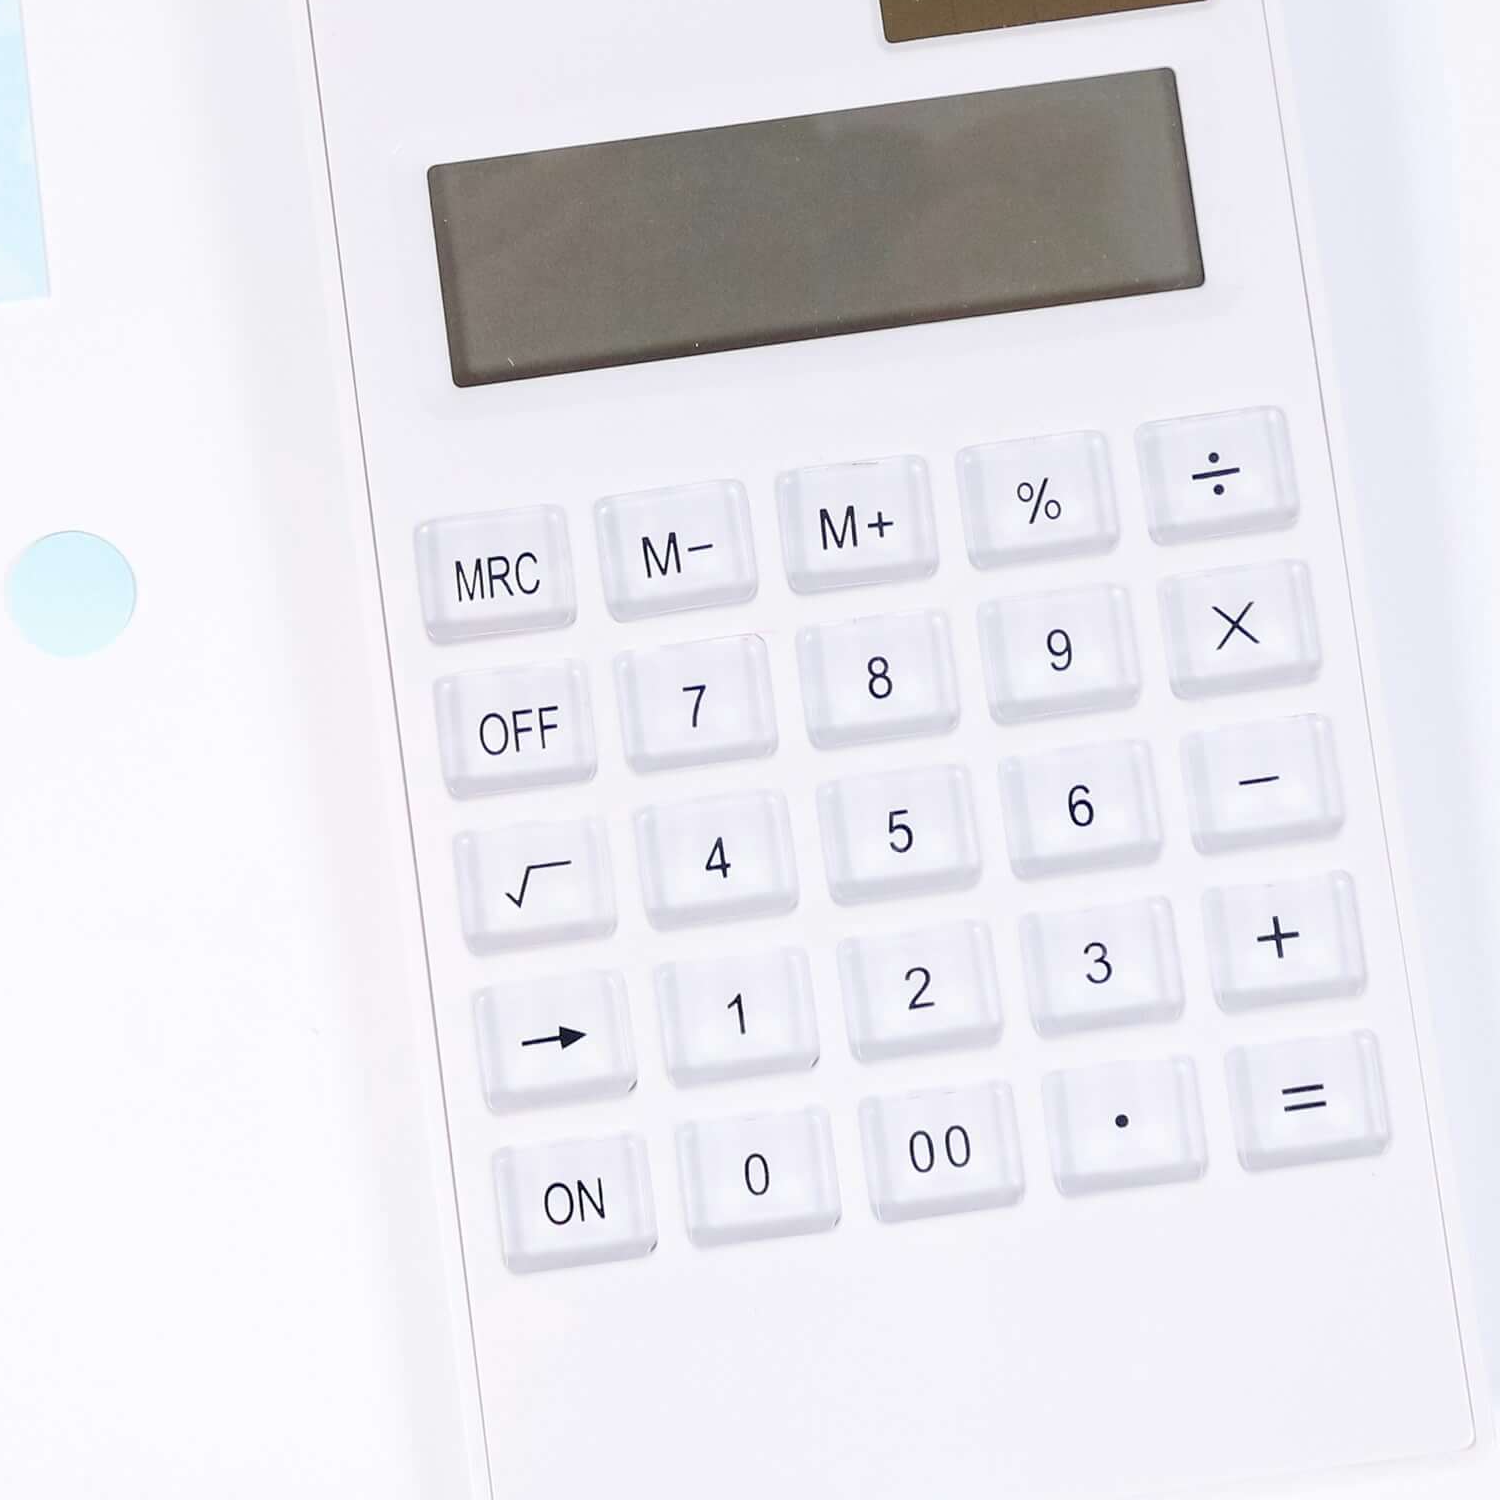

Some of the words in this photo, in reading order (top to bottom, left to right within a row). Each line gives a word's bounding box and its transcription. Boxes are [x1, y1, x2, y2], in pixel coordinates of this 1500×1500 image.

[1016, 477, 1062, 525] %
[819, 505, 894, 551] M+
[454, 551, 541, 602] MRC
[641, 531, 714, 579] M-
[1046, 628, 1073, 672] 9
[867, 656, 893, 700] 8
[682, 684, 707, 728] 7
[479, 705, 559, 756] OFF
[1067, 784, 1094, 827] 6
[888, 809, 914, 854] 5
[705, 836, 732, 879] 4
[1256, 915, 1300, 959] +
[1083, 941, 1113, 984] 3
[904, 966, 935, 1011] 2
[727, 993, 746, 1035] 1
[909, 1125, 971, 1173] 00
[744, 1153, 770, 1196] 0
[543, 1177, 606, 1226] ON
